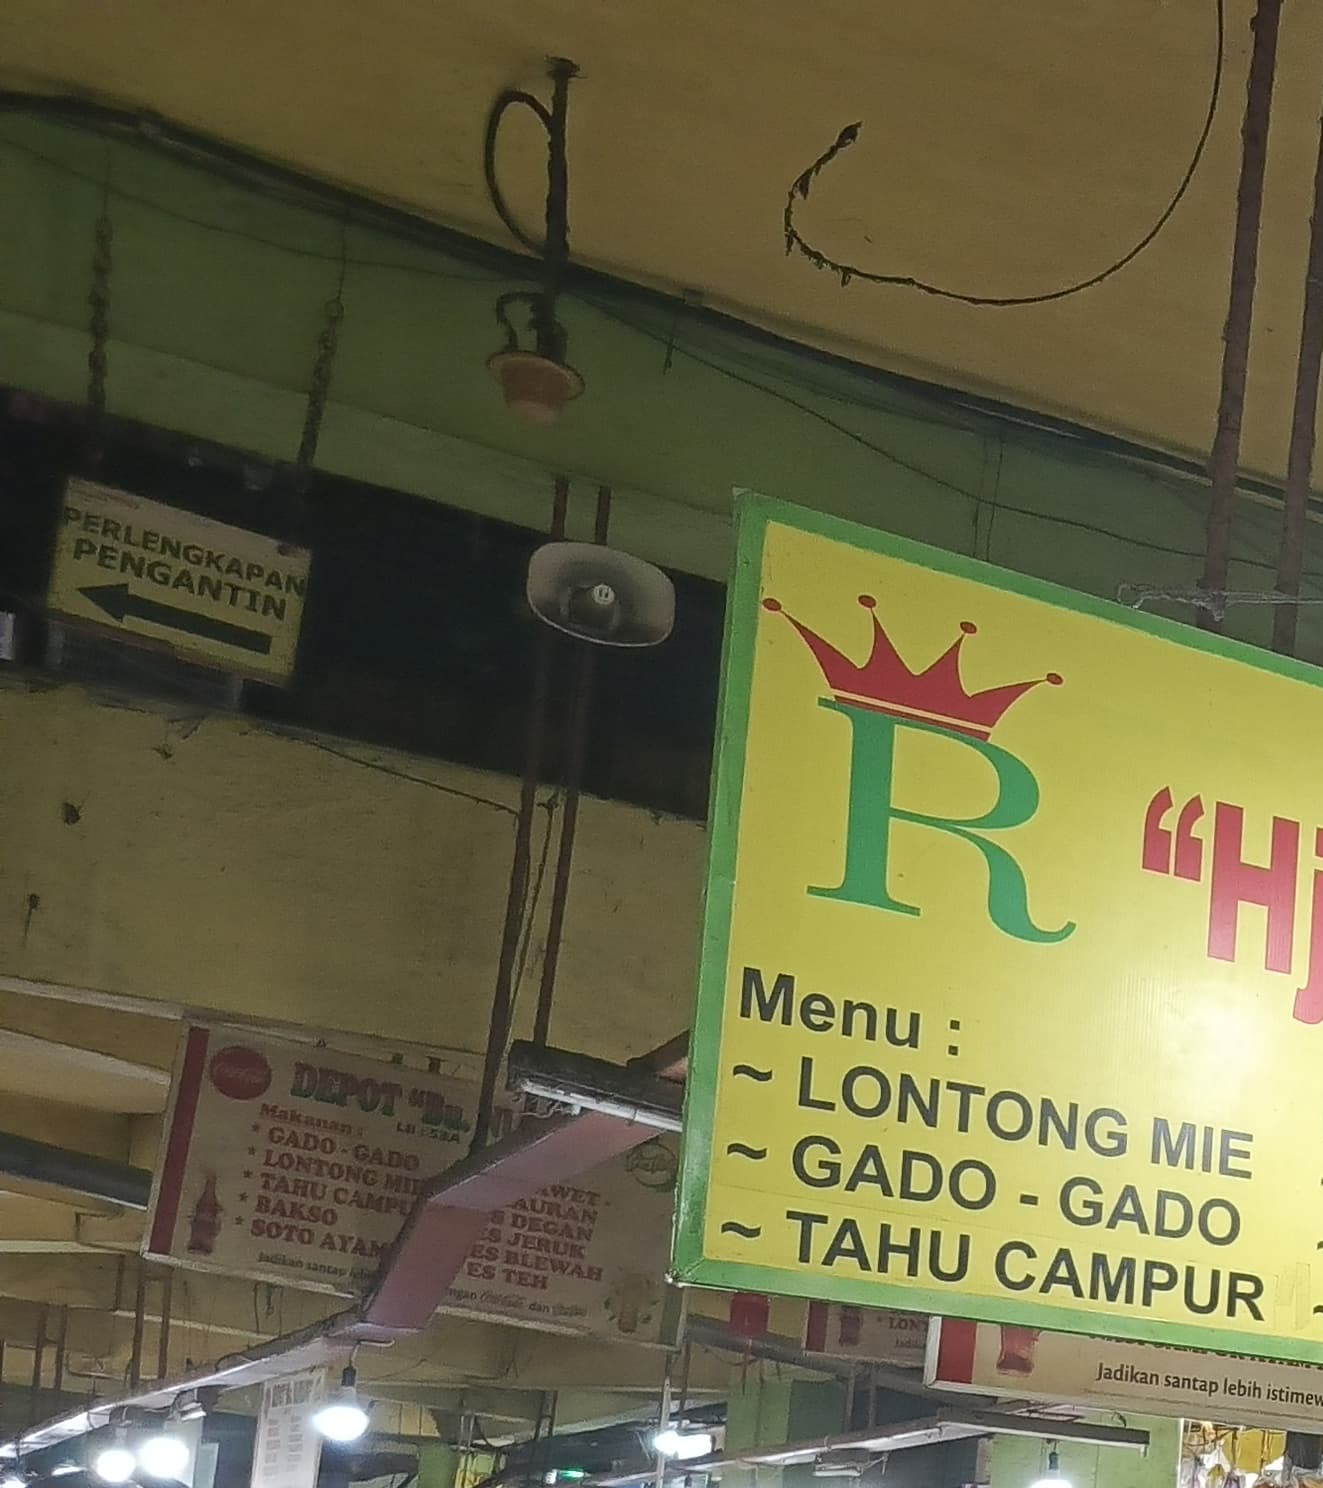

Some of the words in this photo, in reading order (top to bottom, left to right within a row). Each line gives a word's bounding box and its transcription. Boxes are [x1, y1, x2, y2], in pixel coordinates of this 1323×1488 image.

[63, 506, 306, 597] PERLENGKAPAN
[73, 538, 287, 621] PENGANTIN
[806, 696, 1077, 944] R
[738, 967, 921, 1049] Menu
[290, 1061, 403, 1117] DEPOT
[259, 1103, 352, 1136] Makanan
[797, 1056, 1129, 1158] LONTONG
[1151, 1117, 1254, 1180] MIE
[262, 1149, 379, 1187] LONTONG
[268, 1126, 337, 1155] GADO
[353, 1143, 421, 1172] GADO
[254, 1194, 338, 1227] BAKSO
[259, 1171, 329, 1201] TAHU
[333, 1187, 416, 1217] CAMPU
[506, 1198, 599, 1226] AURAN
[791, 1135, 996, 1211] GADO
[1059, 1176, 1242, 1247] GADO
[250, 1218, 316, 1246] SOTO
[506, 1232, 588, 1260] JERUK
[511, 1212, 595, 1242] DEGAN
[465, 1261, 497, 1281] ES
[501, 1267, 550, 1290] TEH
[468, 1243, 499, 1261] ES
[503, 1249, 604, 1282] BLEWAH
[785, 1209, 972, 1283] TAHU
[994, 1239, 1266, 1322] CAMPUR
[1096, 1362, 1160, 1387] Jadikan
[1163, 1370, 1220, 1398] santap
[1222, 1375, 1263, 1399] lebih
